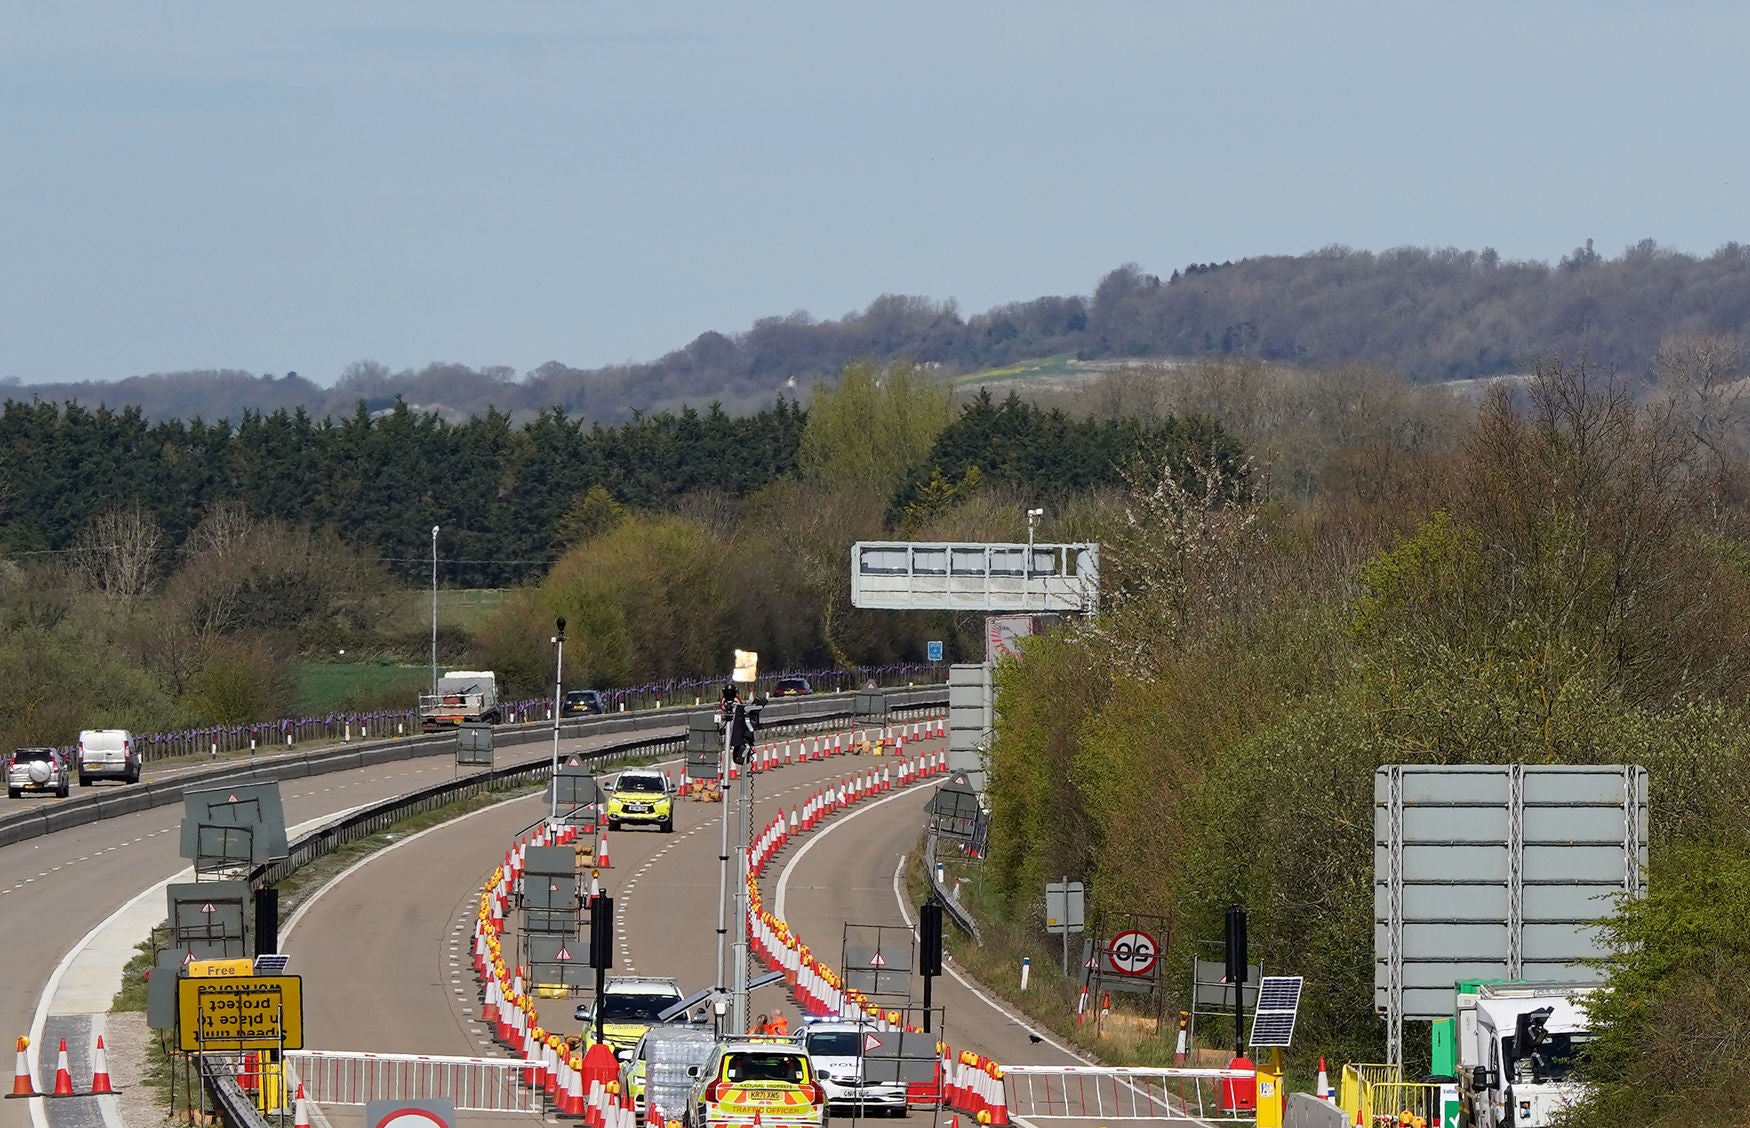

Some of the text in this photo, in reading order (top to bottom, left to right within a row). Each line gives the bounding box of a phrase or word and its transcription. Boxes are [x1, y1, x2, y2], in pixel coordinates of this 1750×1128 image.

[1116, 942, 1150, 962] 50
[207, 965, 236, 976] Free
[210, 998, 270, 1011] protect
[219, 1013, 263, 1027] place
[766, 1106, 800, 1115] OFFICER
